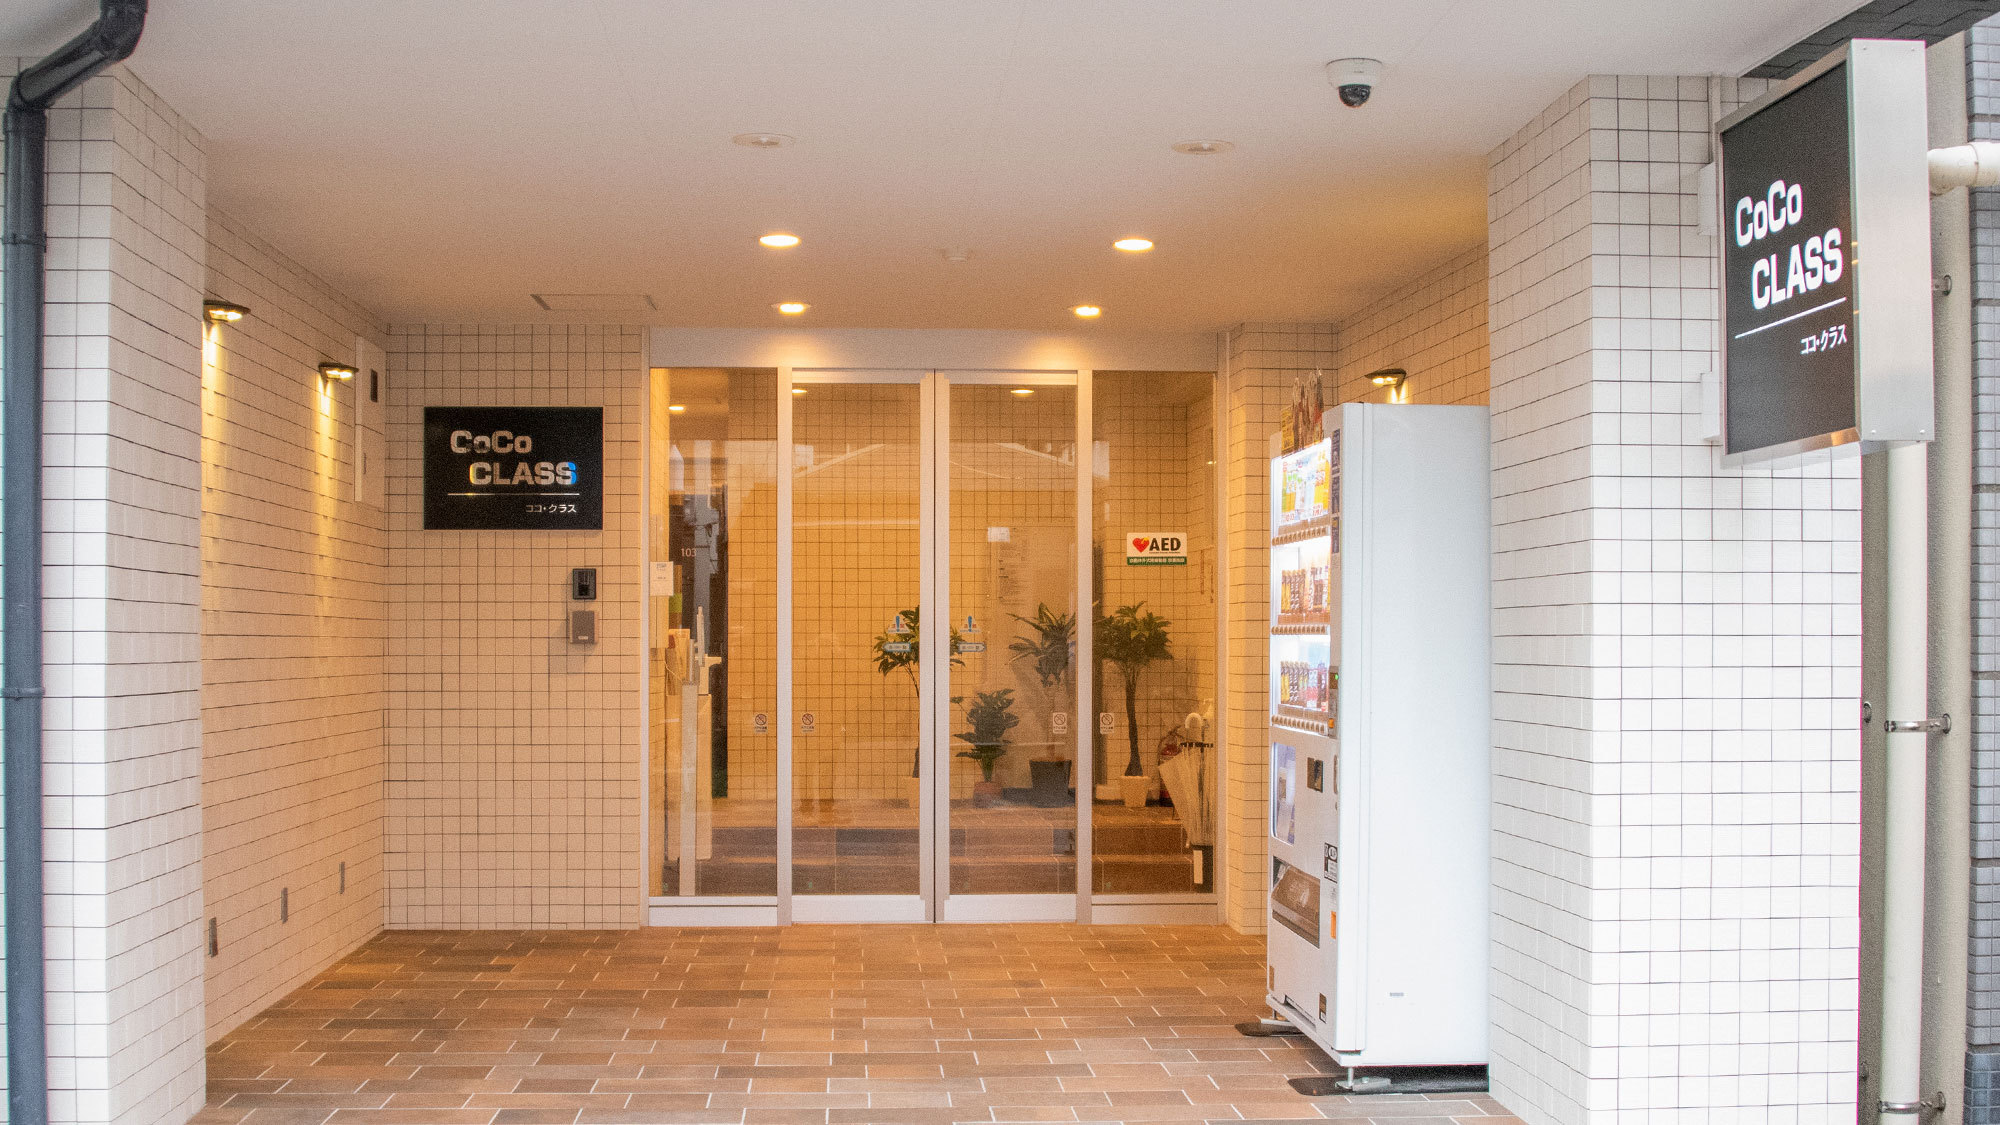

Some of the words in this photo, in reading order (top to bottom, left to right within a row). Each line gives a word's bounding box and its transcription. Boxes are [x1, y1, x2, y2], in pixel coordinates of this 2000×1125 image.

[1735, 179, 1803, 248] CoCo
[1751, 227, 1844, 310] CLASS
[1800, 323, 1848, 355] ココ・クラス
[450, 430, 532, 454] CoCo
[469, 461, 577, 486] CLASS
[525, 503, 577, 514] ココ・クラス
[680, 547, 697, 558] 103
[1149, 537, 1182, 552] AED
